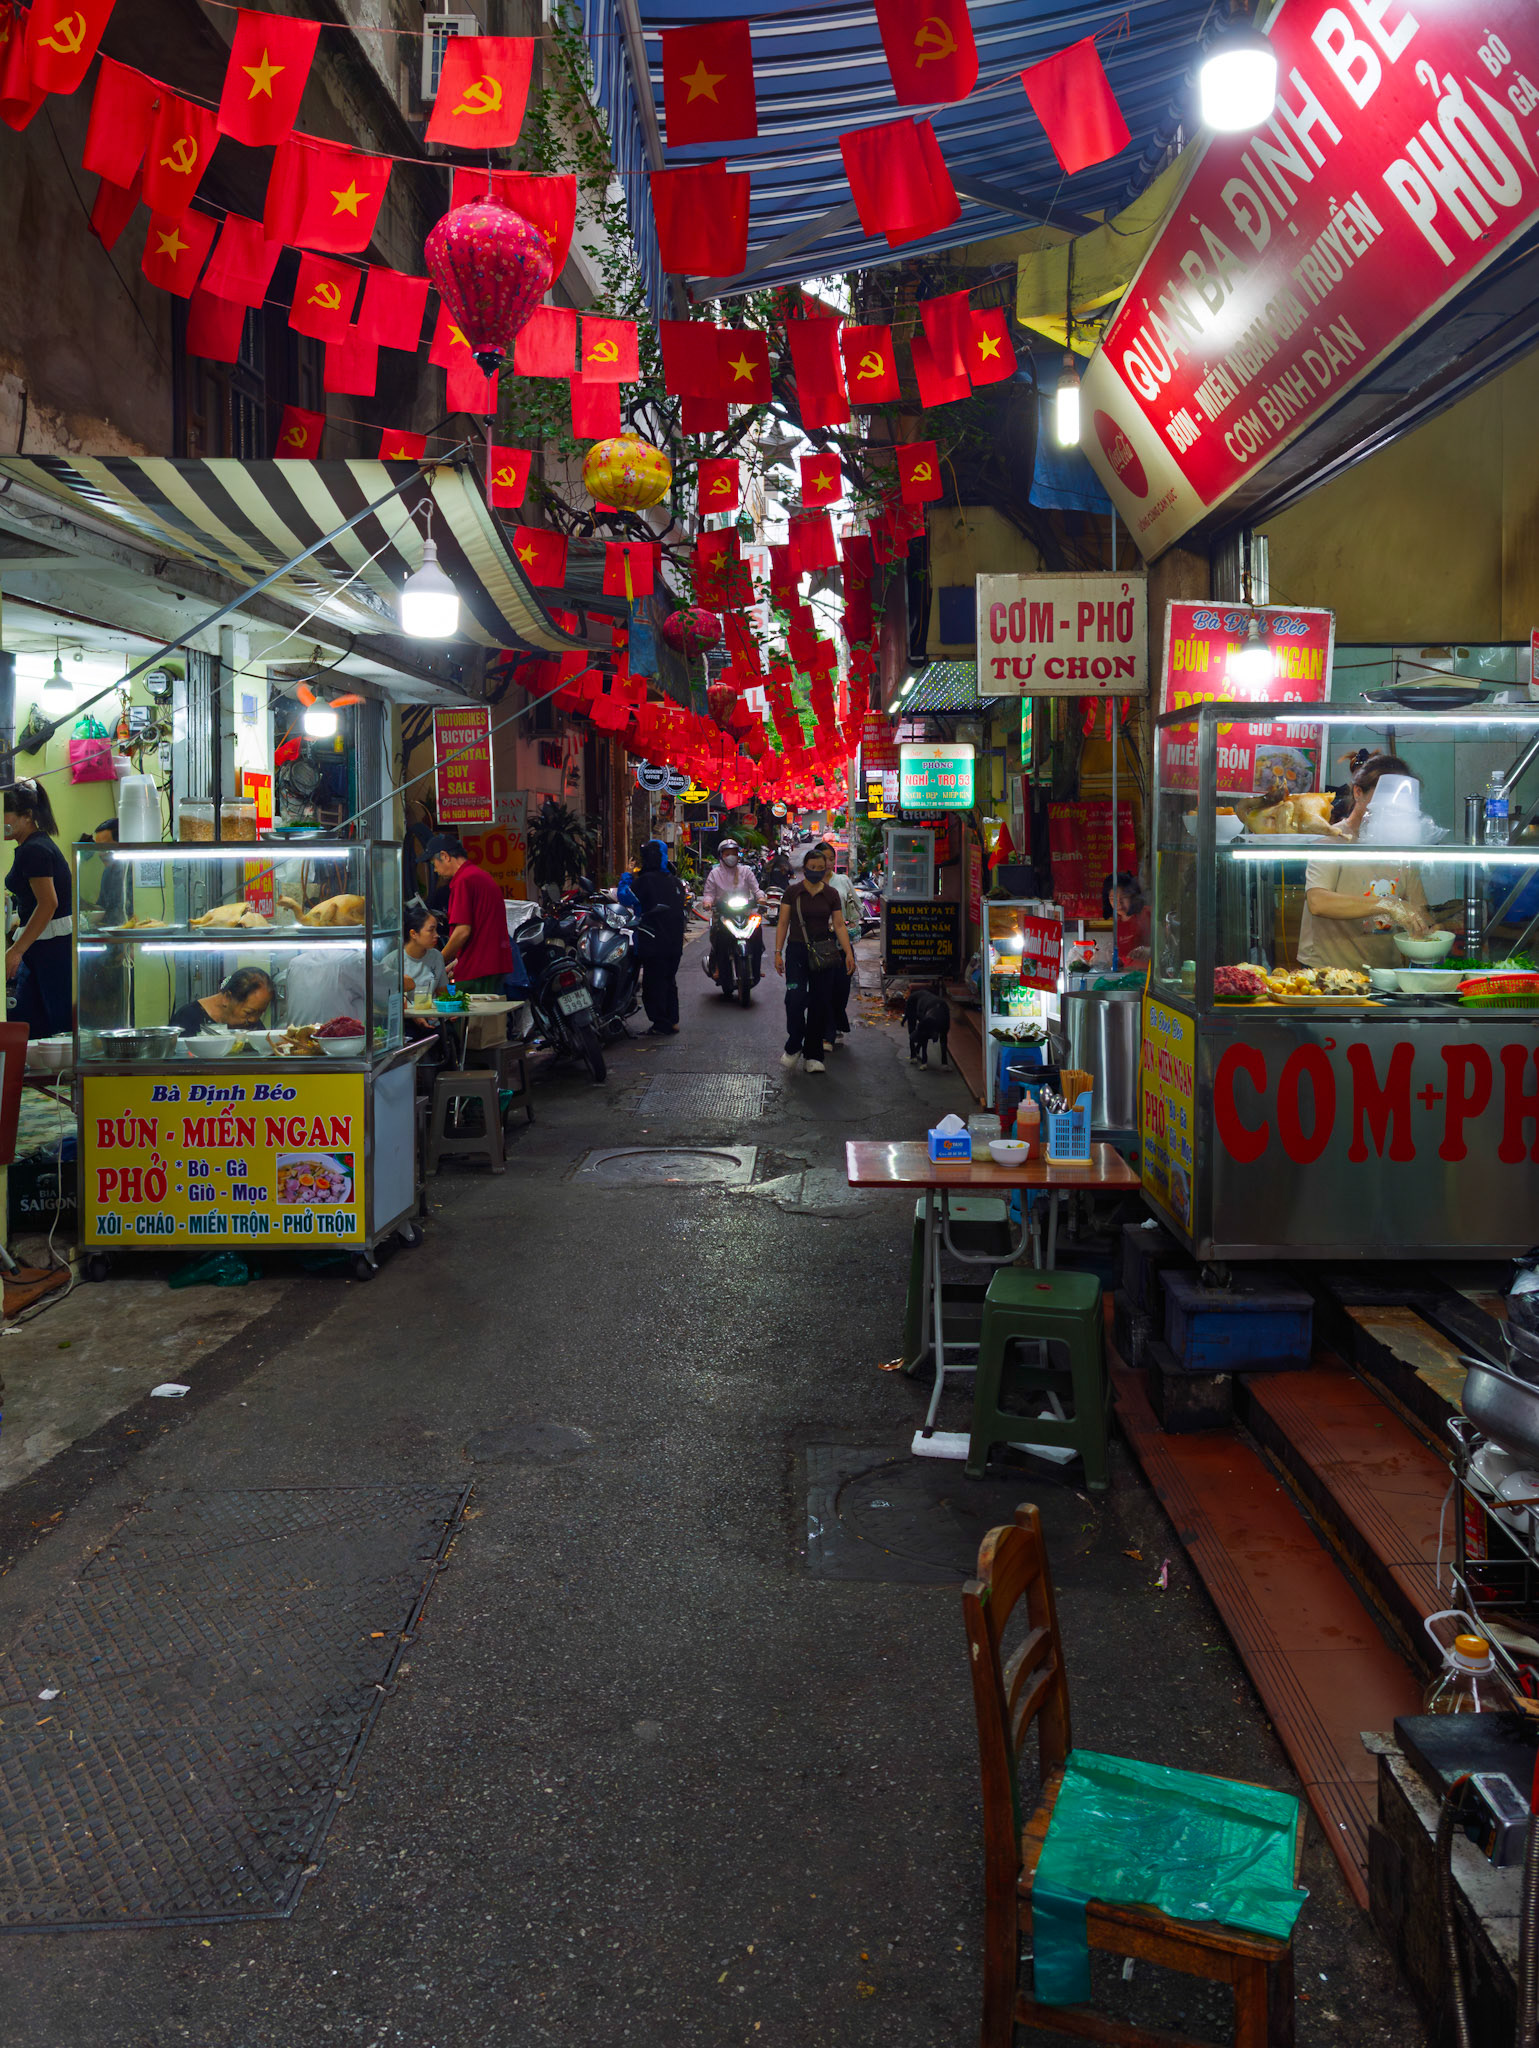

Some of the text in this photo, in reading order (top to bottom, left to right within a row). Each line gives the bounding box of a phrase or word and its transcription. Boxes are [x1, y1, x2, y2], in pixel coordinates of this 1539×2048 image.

[1477, 28, 1511, 78] BÒ
[1508, 70, 1539, 116] GÀ
[1382, 59, 1523, 267] PHỞ
[1122, 278, 1204, 401] QUÁN
[1180, 215, 1248, 316] BÀ
[1220, 66, 1343, 254] ĐỊNH
[1165, 407, 1202, 454] BÚN
[1194, 361, 1240, 423] MIẾN
[1224, 317, 1280, 387] NGAN
[1264, 287, 1310, 341] GIA
[1290, 190, 1384, 306] TRUYỀN
[1225, 313, 1366, 463] CƠM BÌNH DÂN
[989, 597, 1052, 644] CƠM
[1077, 583, 1135, 643] PHỞ
[1192, 610, 1310, 636] Bà Địh Béo
[1173, 633, 1209, 673] BÚN
[990, 655, 1136, 688] TỰ CHỌN
[437, 712, 486, 727] MOTORBIKES
[441, 729, 484, 743] BICYCLE
[446, 748, 489, 760] RENTAL
[447, 766, 468, 778] BUY
[447, 783, 475, 794] SALE
[905, 770, 929, 786] NGHỈ
[937, 774, 956, 789] TRỌ
[958, 774, 970, 786] 53
[884, 804, 896, 812] 47
[462, 833, 526, 866] 50%
[1150, 1005, 1157, 1028] Bà
[1158, 1010, 1171, 1037] Định
[1172, 1017, 1183, 1041] Béo
[1174, 1055, 1192, 1098] NGAN
[150, 1082, 297, 1105] Bà Định Béo
[96, 1109, 158, 1149] BÚN
[182, 1103, 257, 1148] MIẾN
[265, 1115, 352, 1147] NGAN
[1145, 1083, 1165, 1139] PHỞ
[40, 1190, 57, 1198] BIA
[97, 1152, 168, 1204] PHỞ
[188, 1159, 209, 1178] Bò
[227, 1159, 248, 1178] Gà
[188, 1183, 218, 1202] Giò
[232, 1184, 268, 1206] Mọc
[96, 1213, 122, 1236] XÔI
[135, 1210, 175, 1235] CHÁO
[189, 1208, 228, 1235] MIẾN
[231, 1210, 270, 1238] TRỘN
[282, 1208, 314, 1234] PHỞ
[316, 1210, 356, 1238] TRỘN
